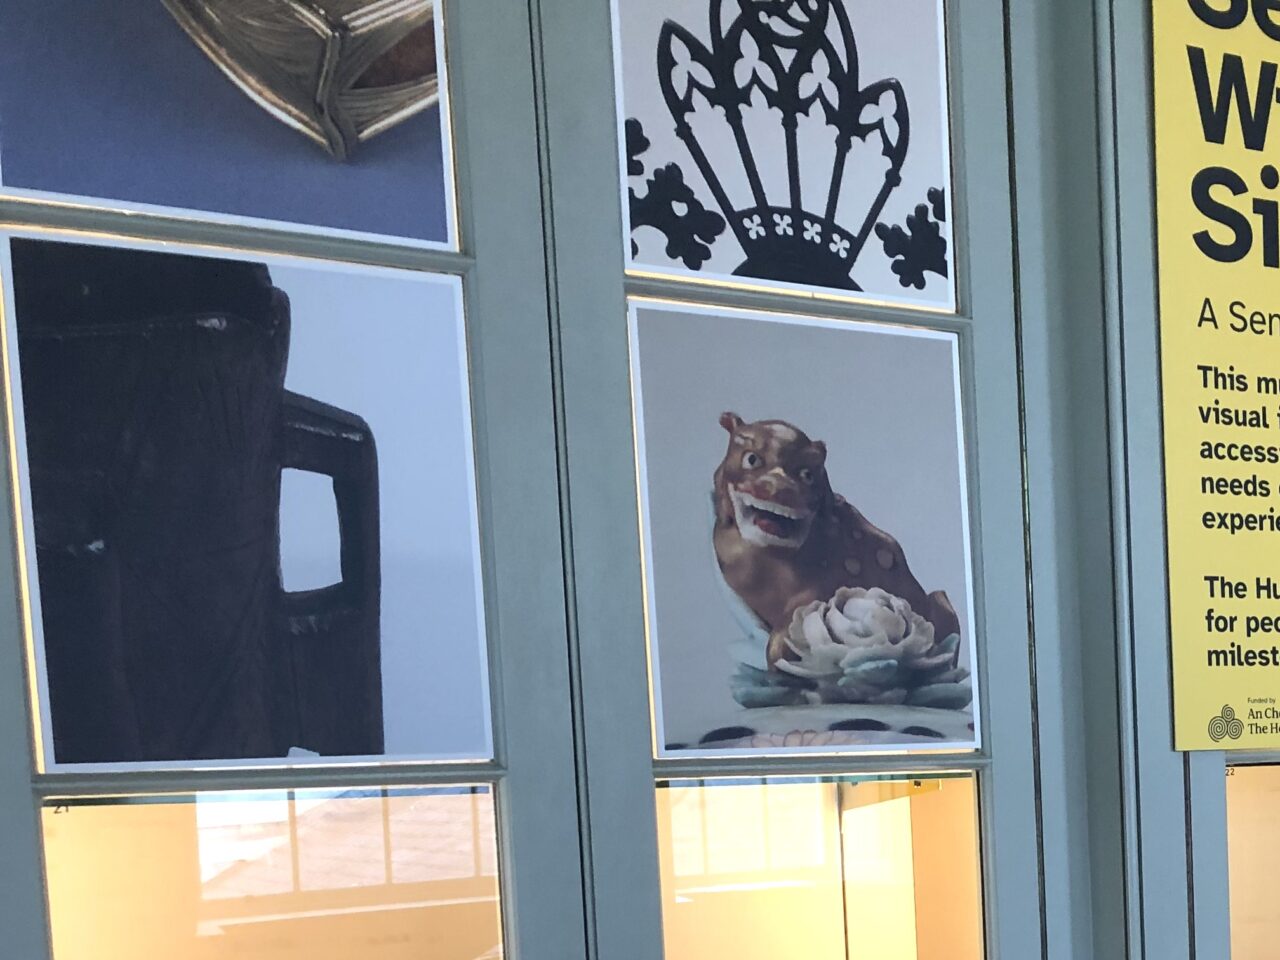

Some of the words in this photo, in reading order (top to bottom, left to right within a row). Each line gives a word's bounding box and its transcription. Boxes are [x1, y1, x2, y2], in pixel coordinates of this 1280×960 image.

[1197, 298, 1218, 329] A
[1197, 365, 1248, 392] This
[1199, 400, 1269, 429] visual
[1201, 474, 1270, 497] needs
[1204, 576, 1247, 599] The
[1205, 608, 1237, 633] for
[1247, 706, 1263, 718] An
[1247, 721, 1268, 734] The
